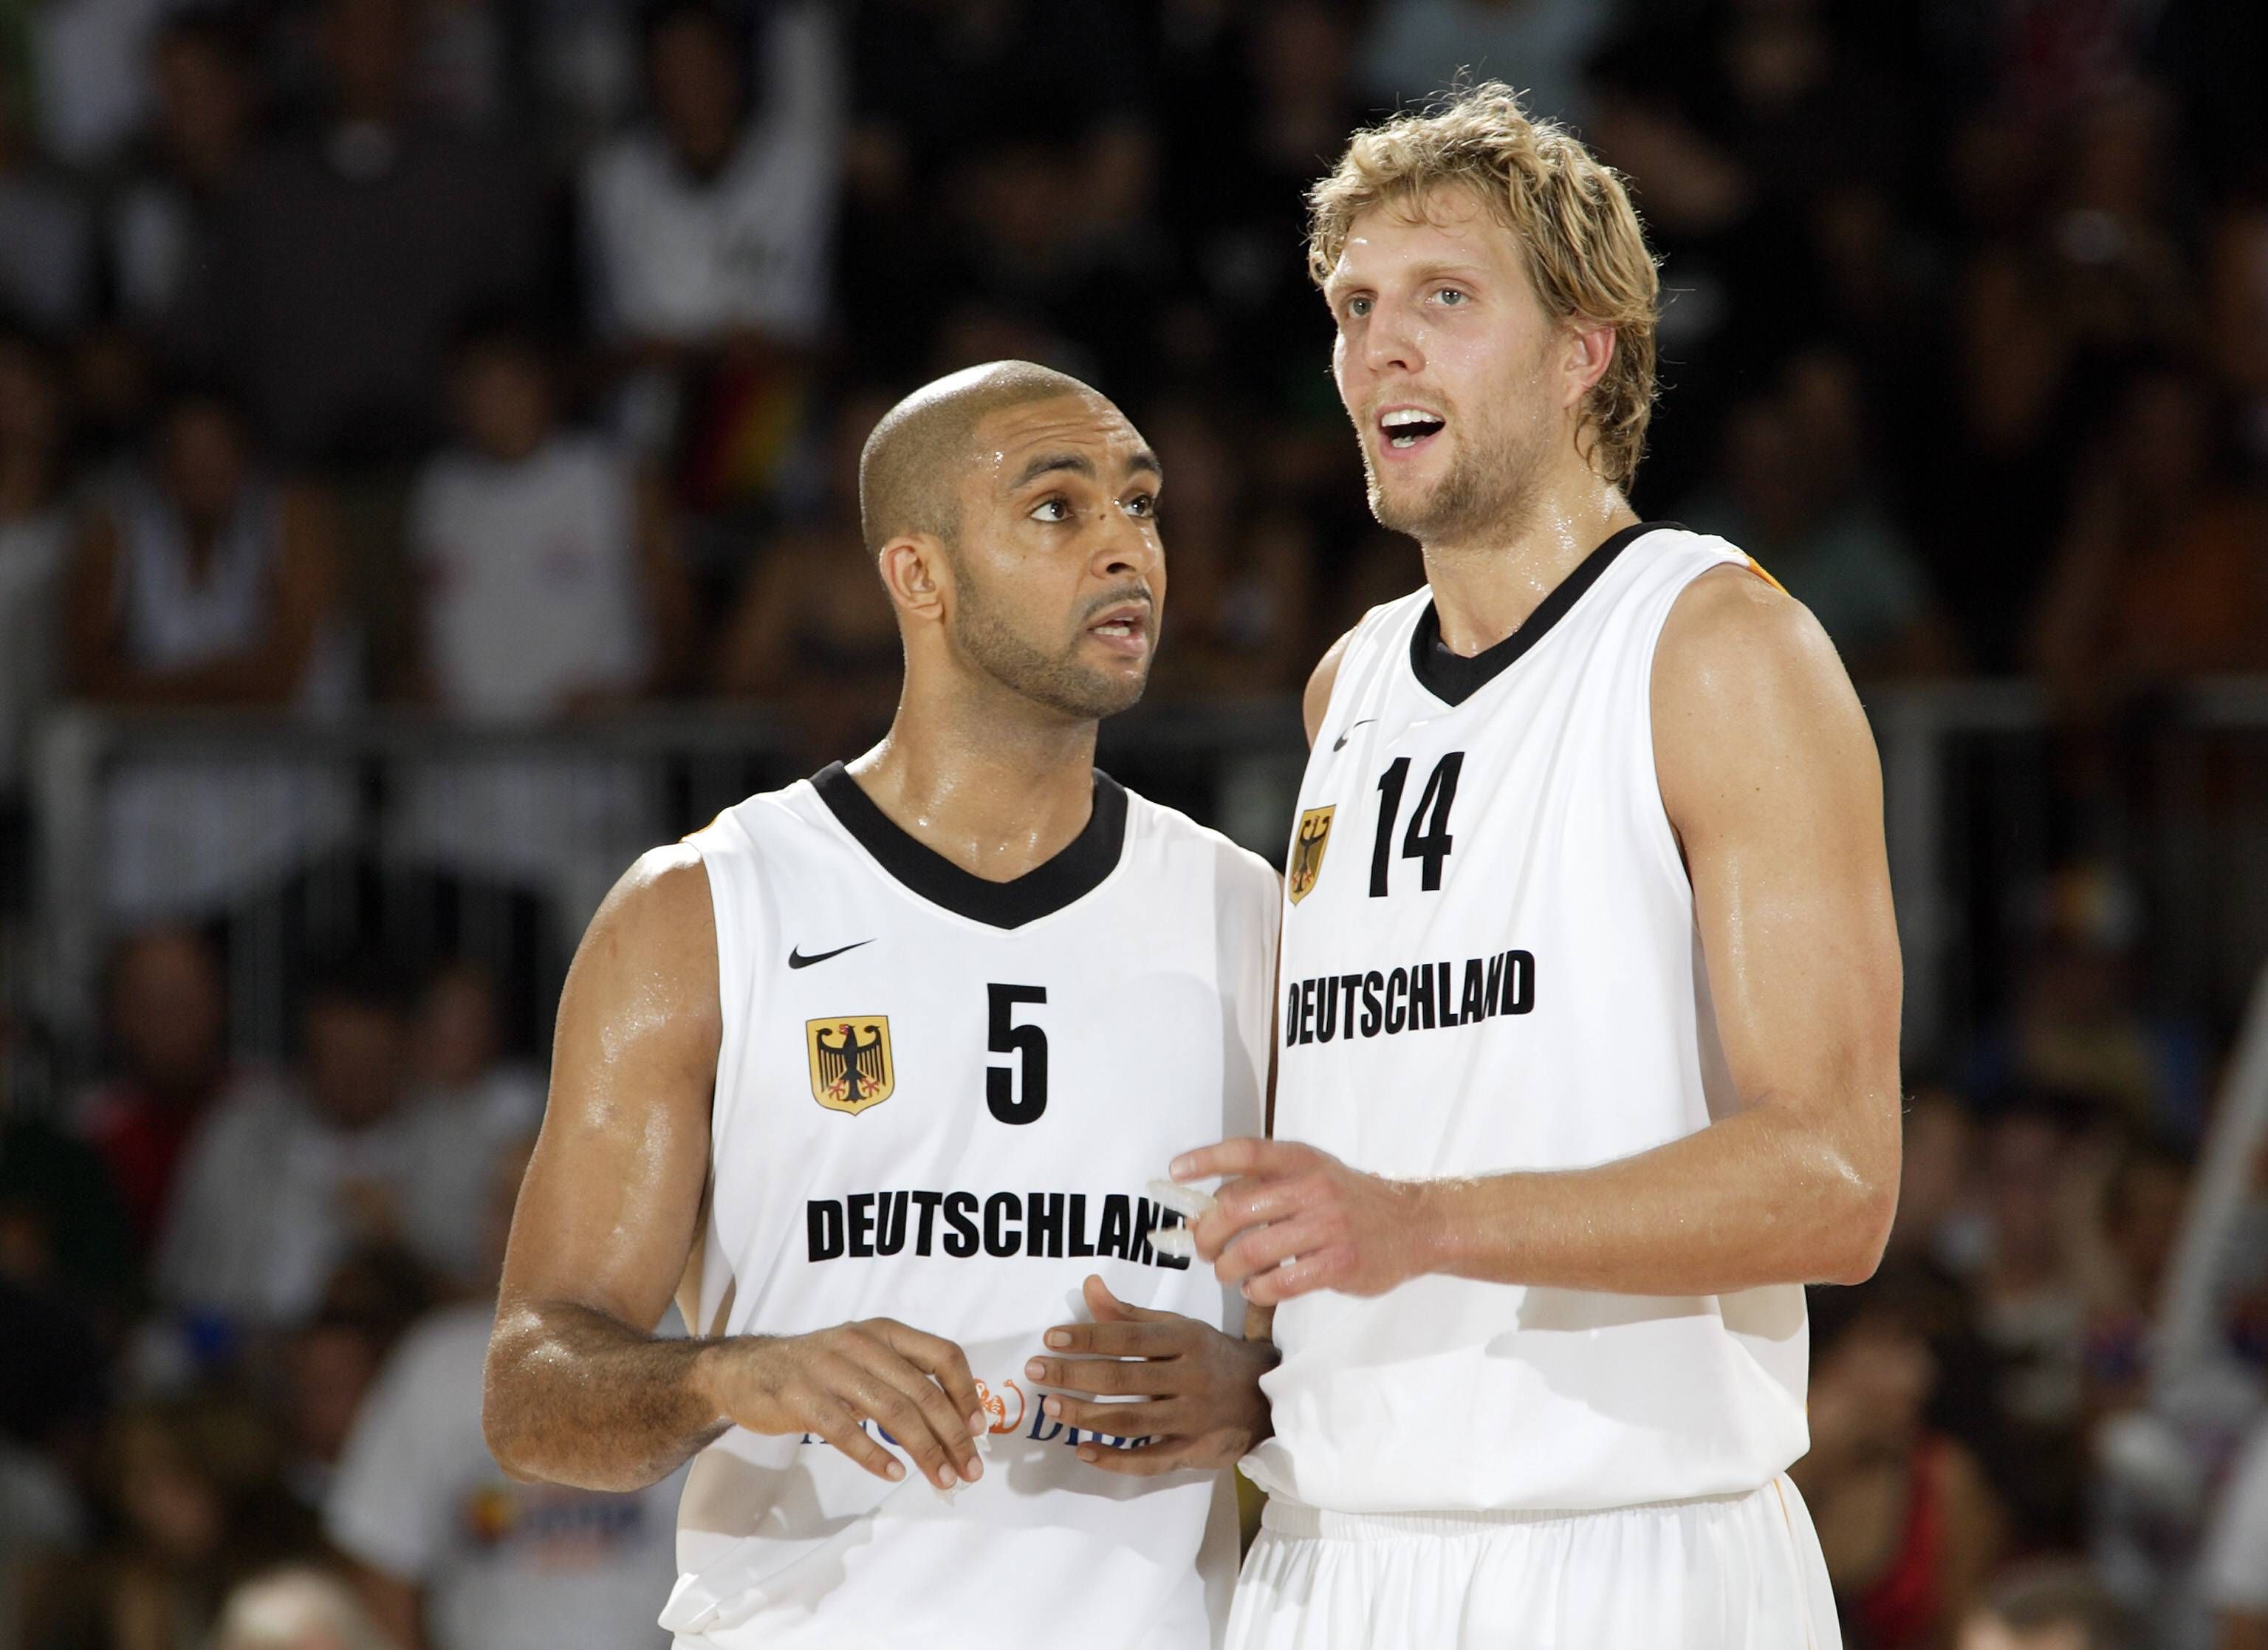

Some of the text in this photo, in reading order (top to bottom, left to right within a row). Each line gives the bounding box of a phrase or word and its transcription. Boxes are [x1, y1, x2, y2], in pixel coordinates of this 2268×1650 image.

[1369, 752, 1464, 897] 14
[987, 983, 1047, 1125] 5
[1287, 950, 1535, 1047] DEUTSCHLAND
